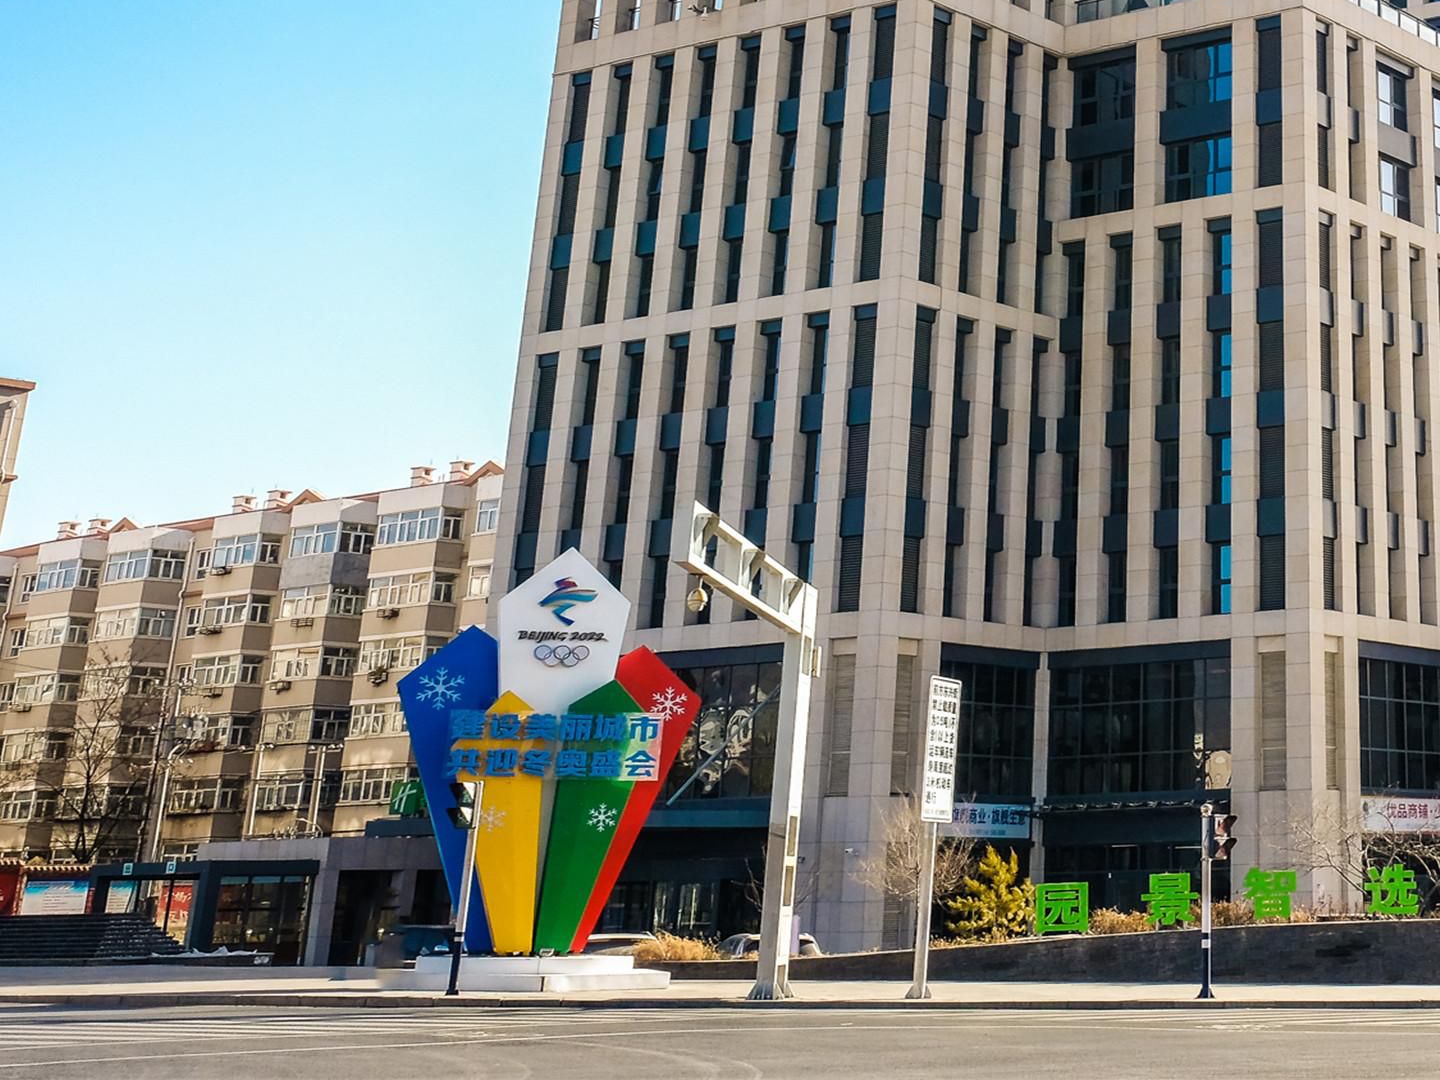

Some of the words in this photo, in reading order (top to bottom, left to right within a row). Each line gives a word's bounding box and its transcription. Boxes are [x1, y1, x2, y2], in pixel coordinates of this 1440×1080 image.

[517, 630, 568, 643] BEIJING
[569, 631, 609, 643] 2022
[450, 712, 659, 742] 建设美丽城市
[447, 748, 657, 777] 共迎冬奥盛会
